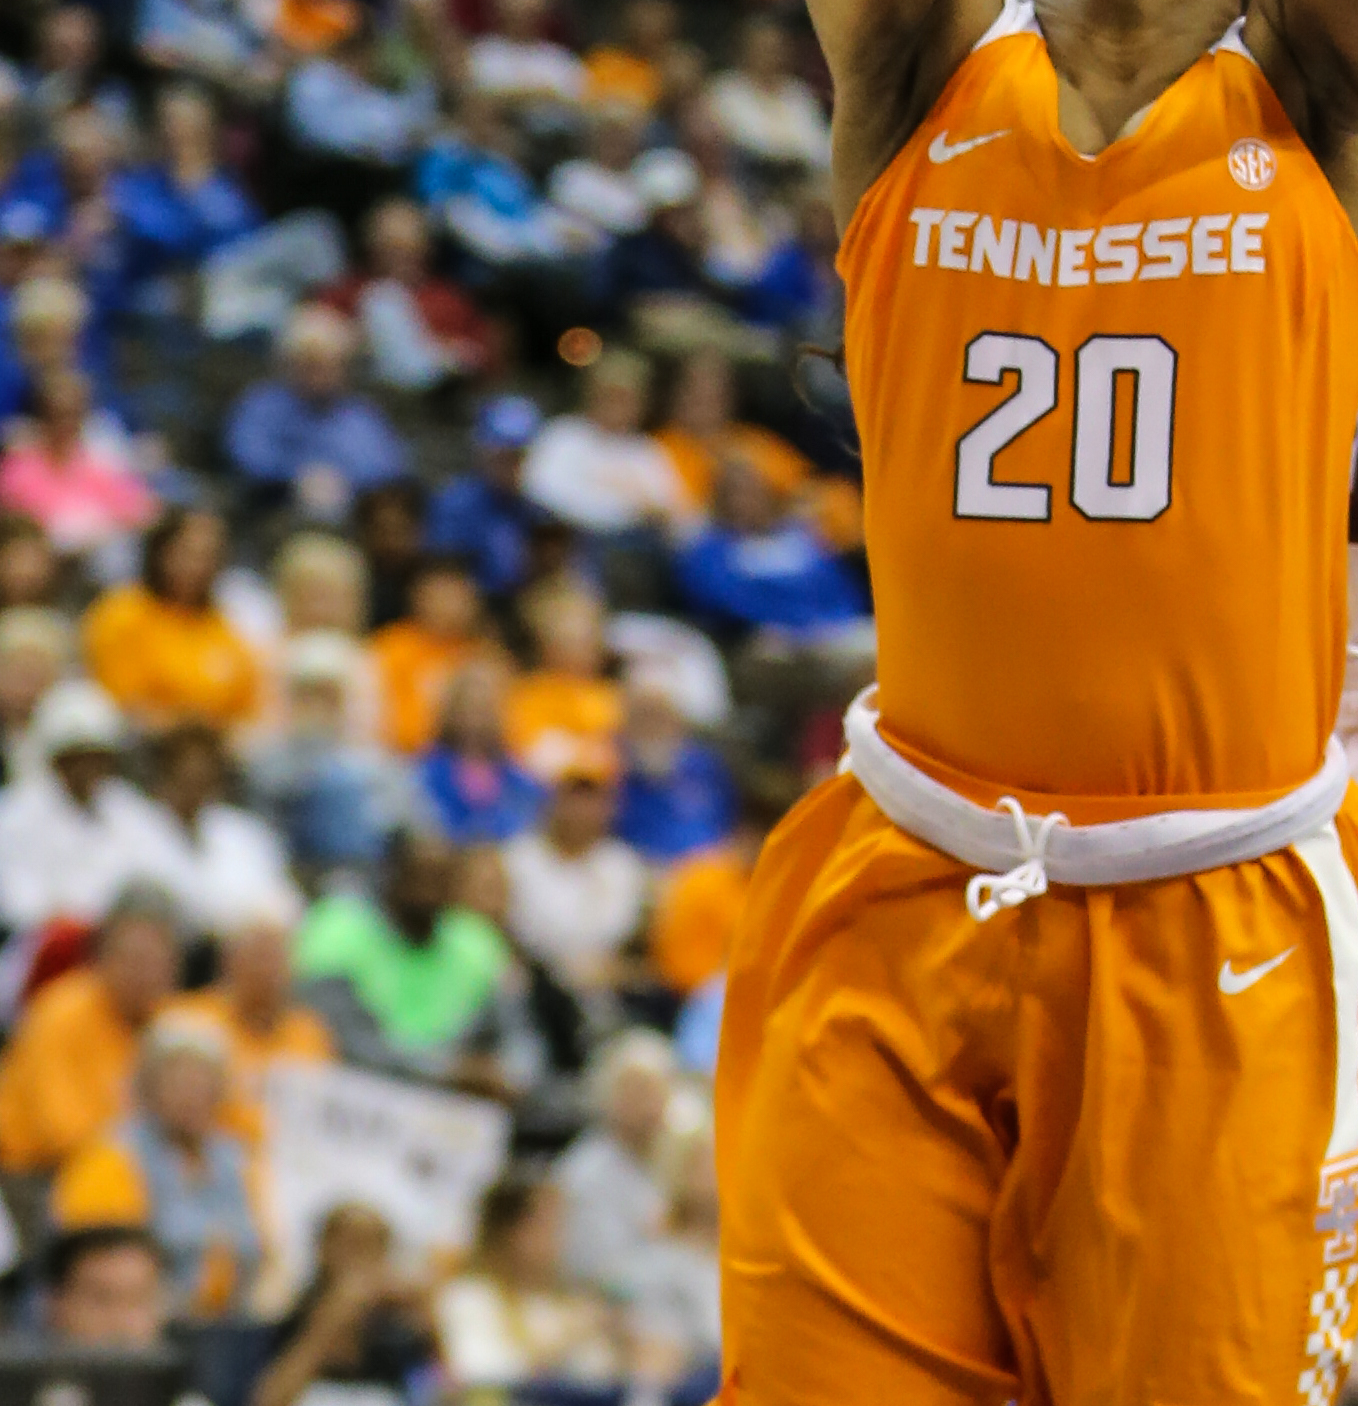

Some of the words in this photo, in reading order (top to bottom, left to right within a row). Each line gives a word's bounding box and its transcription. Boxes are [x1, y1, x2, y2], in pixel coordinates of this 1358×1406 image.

[1231, 142, 1273, 185] SEC
[909, 206, 1270, 287] TENNESSEE
[953, 329, 1178, 522] 20
